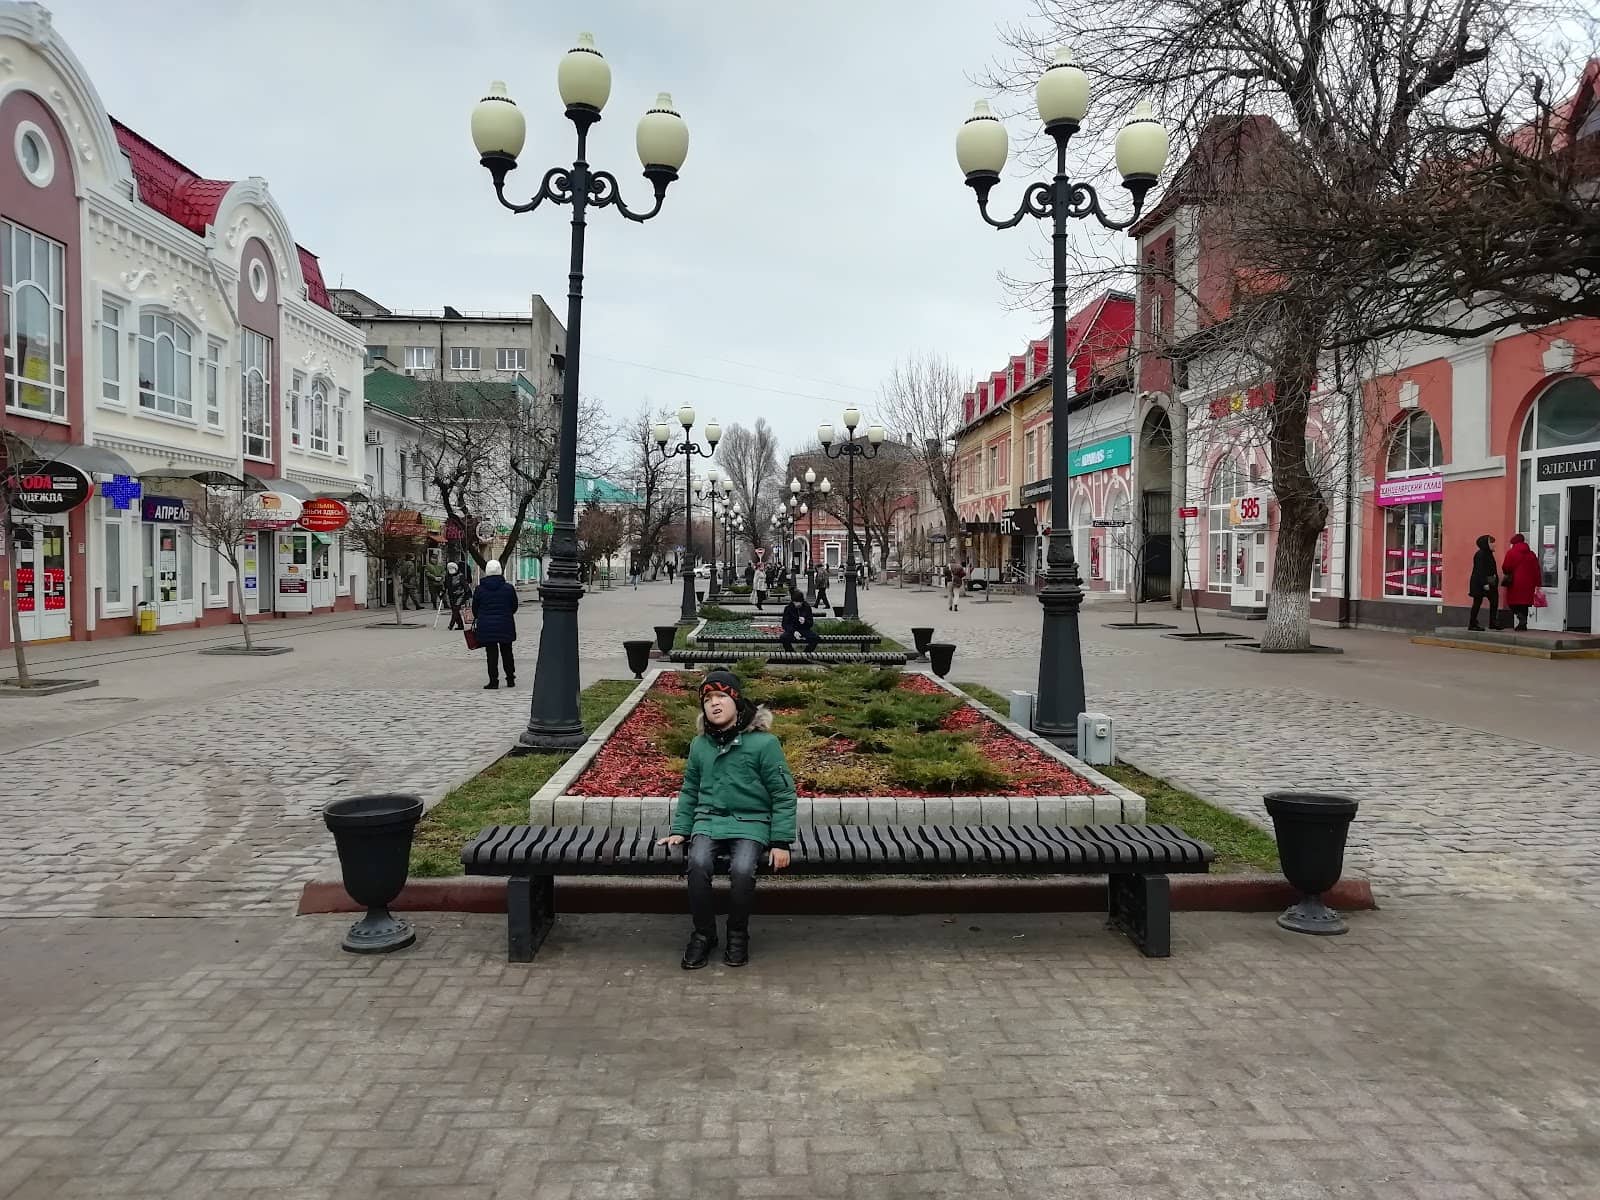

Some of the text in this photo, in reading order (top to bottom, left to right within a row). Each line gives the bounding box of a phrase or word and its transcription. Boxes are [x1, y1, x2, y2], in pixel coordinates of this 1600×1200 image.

[1542, 458, 1597, 475] ЭЛЕГАНТ
[19, 492, 63, 504] ОДЕЖДА
[154, 504, 190, 521] АПРЕЛЬ
[1240, 497, 1260, 520] 585
